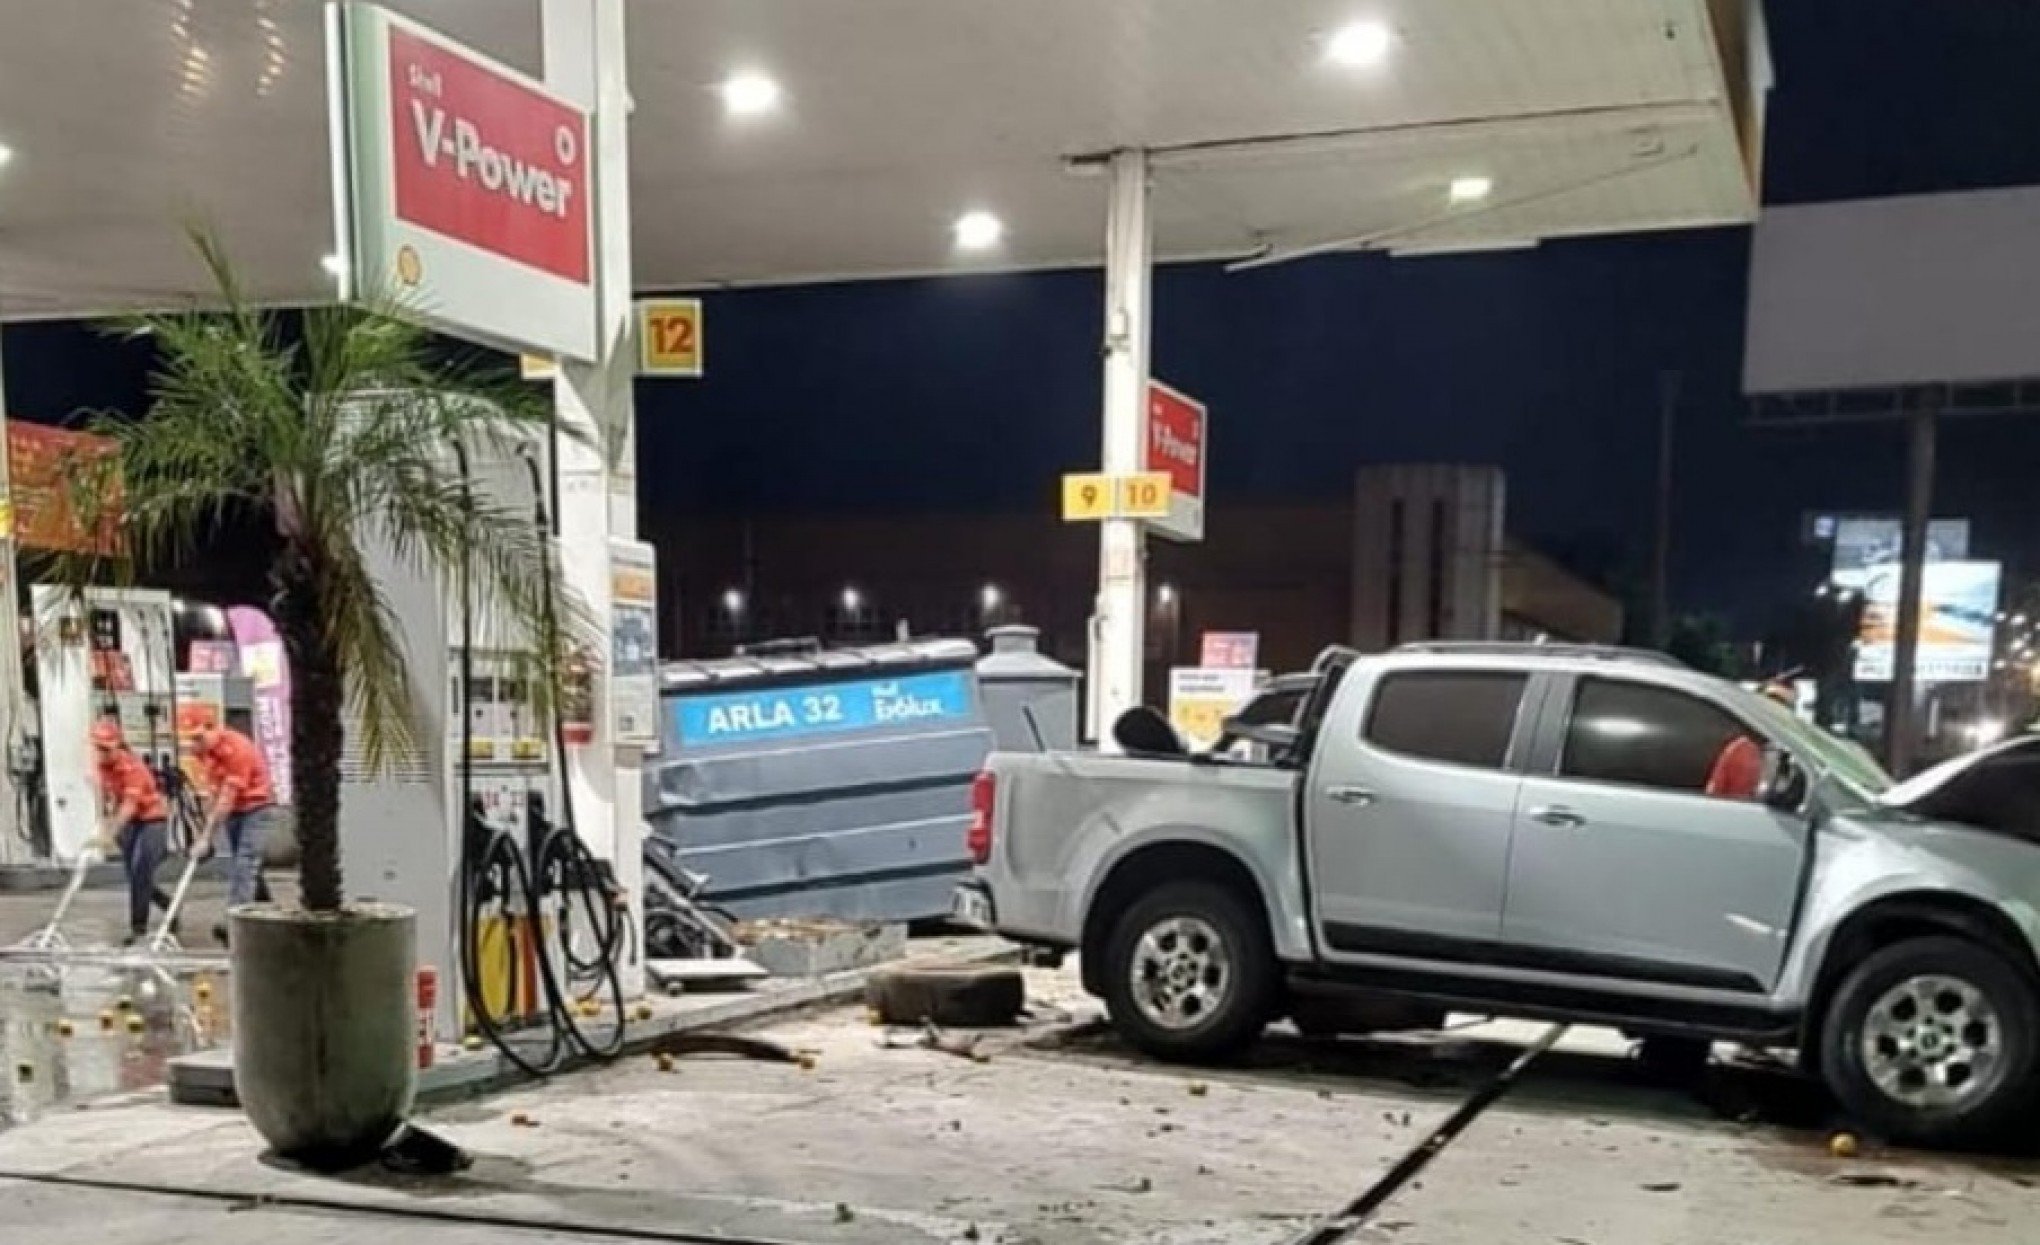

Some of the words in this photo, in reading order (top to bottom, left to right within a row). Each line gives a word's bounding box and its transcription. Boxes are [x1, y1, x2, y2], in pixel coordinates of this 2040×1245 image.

[411, 98, 573, 219] V-Power
[648, 316, 695, 354] 12
[1080, 484, 1098, 508] 9
[1126, 484, 1157, 506] 10
[708, 699, 797, 735] ARLA
[802, 694, 844, 725] 32
